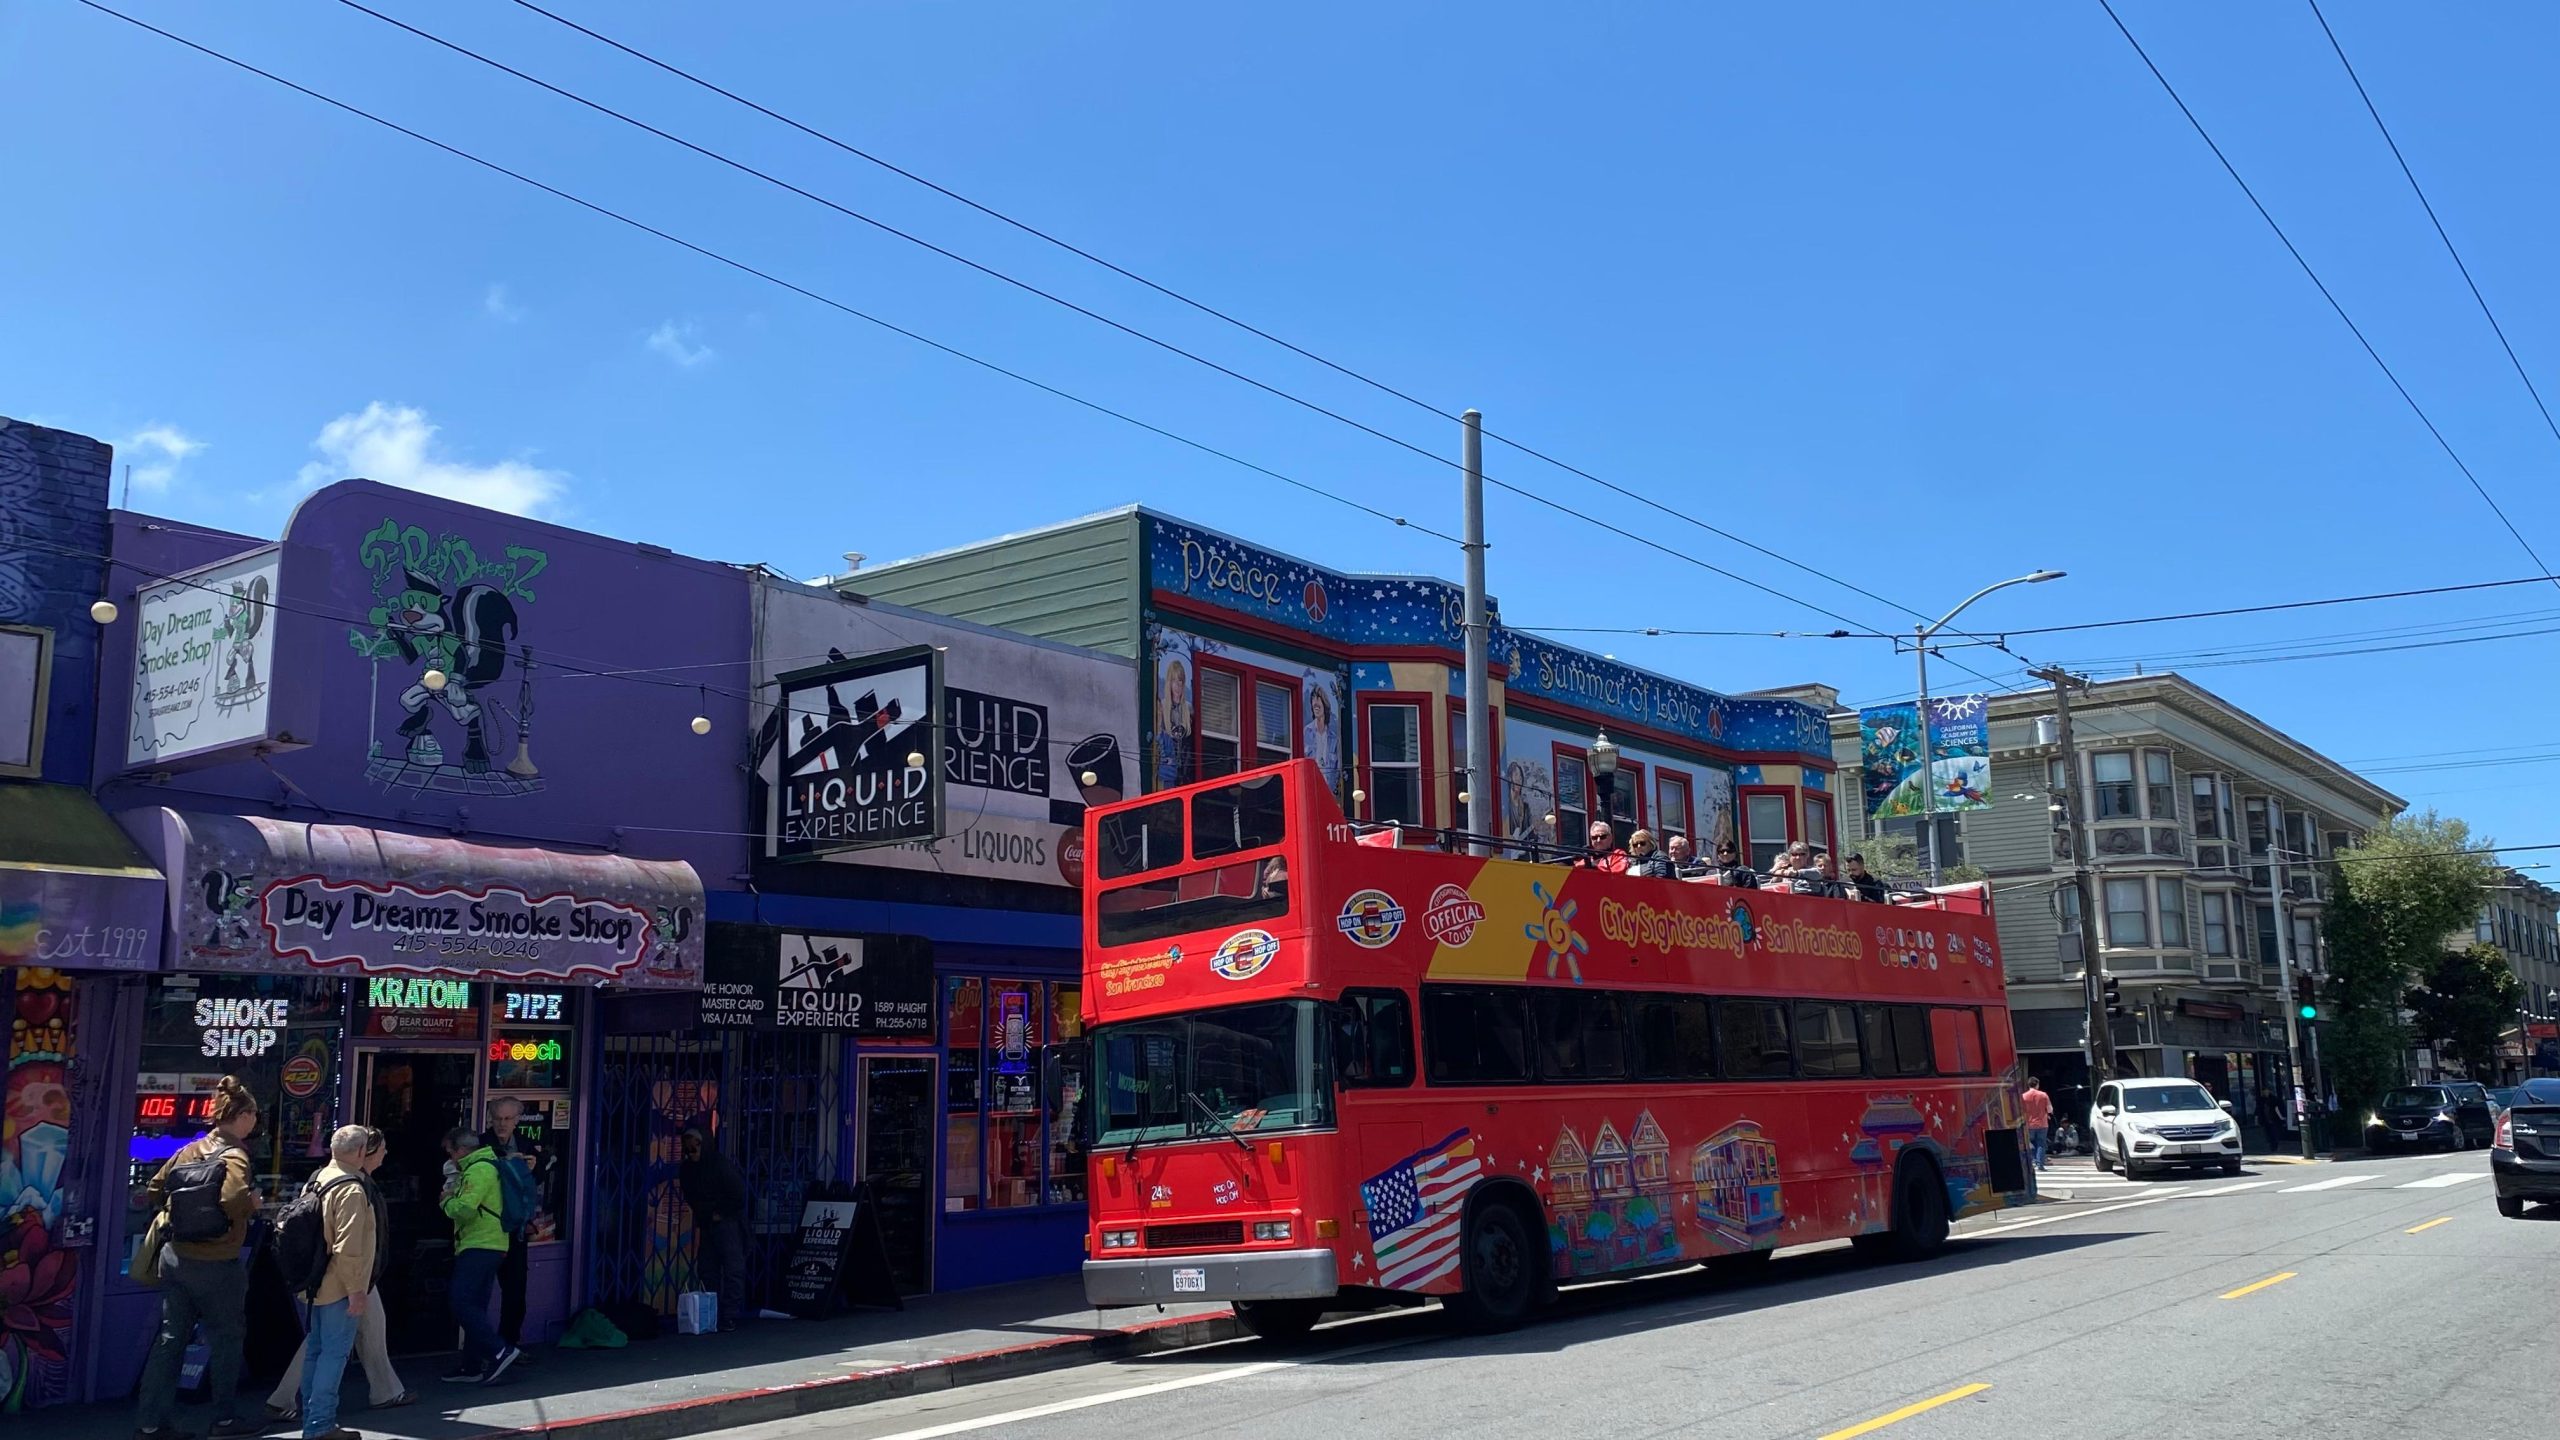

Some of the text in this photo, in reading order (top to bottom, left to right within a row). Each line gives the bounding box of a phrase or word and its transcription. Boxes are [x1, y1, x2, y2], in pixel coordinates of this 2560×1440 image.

[1180, 539, 1281, 603] Peace
[143, 608, 212, 646] Day Dreamz
[1440, 594, 1495, 643] 197
[139, 637, 211, 675] Smoke Shop
[144, 678, 201, 704] 415-554-0246
[1539, 650, 1700, 728] Summer of Love
[956, 696, 1042, 754] UID
[1795, 707, 1828, 746] 1967
[1940, 724, 1978, 733] CALIFORNIA
[1940, 737, 1978, 747] SCIENCES
[945, 746, 1043, 793] RIENCE
[785, 801, 926, 843] EXPERIENCE
[1326, 823, 1347, 843] 117
[963, 829, 1046, 866] LIQUORS
[1892, 880, 1923, 889] AYTON
[283, 887, 632, 953] Day Dreamz Smoke Shop
[1340, 916, 1361, 928] HOP ON
[1381, 910, 1403, 922] HOP OFF
[1429, 904, 1482, 933] OFFICIAL
[35, 927, 147, 960] Est 1999
[1448, 926, 1472, 943] TOUR
[1762, 914, 1794, 952] San
[1793, 916, 1862, 960] Francisco
[1254, 942, 1277, 955] HOP OFF
[1213, 955, 1233, 968] HOP ON
[368, 977, 469, 1009] KRATOM
[703, 983, 754, 995] WE HONOR
[1106, 973, 1165, 996] San Francisco
[504, 993, 562, 1020] PIPE
[702, 998, 764, 1011] MASTER CARD
[777, 990, 863, 1012] LIQUID
[874, 1002, 927, 1013] 1589 HAIGHT
[194, 998, 289, 1027] SMOKE
[399, 1017, 454, 1028] BEAR QUARTZ
[777, 1011, 860, 1027] EXPERIENCE
[201, 1029, 277, 1057] SHOP
[488, 1039, 561, 1061] cheech
[284, 1071, 319, 1083] 420
[141, 1098, 175, 1116] 106
[1151, 1185, 1162, 1201] 24
[1213, 1180, 1236, 1194] Hop On
[1216, 1190, 1239, 1205] Hop Off
[803, 1237, 840, 1245] EXPERIENCE
[805, 1229, 842, 1238] LIQUID
